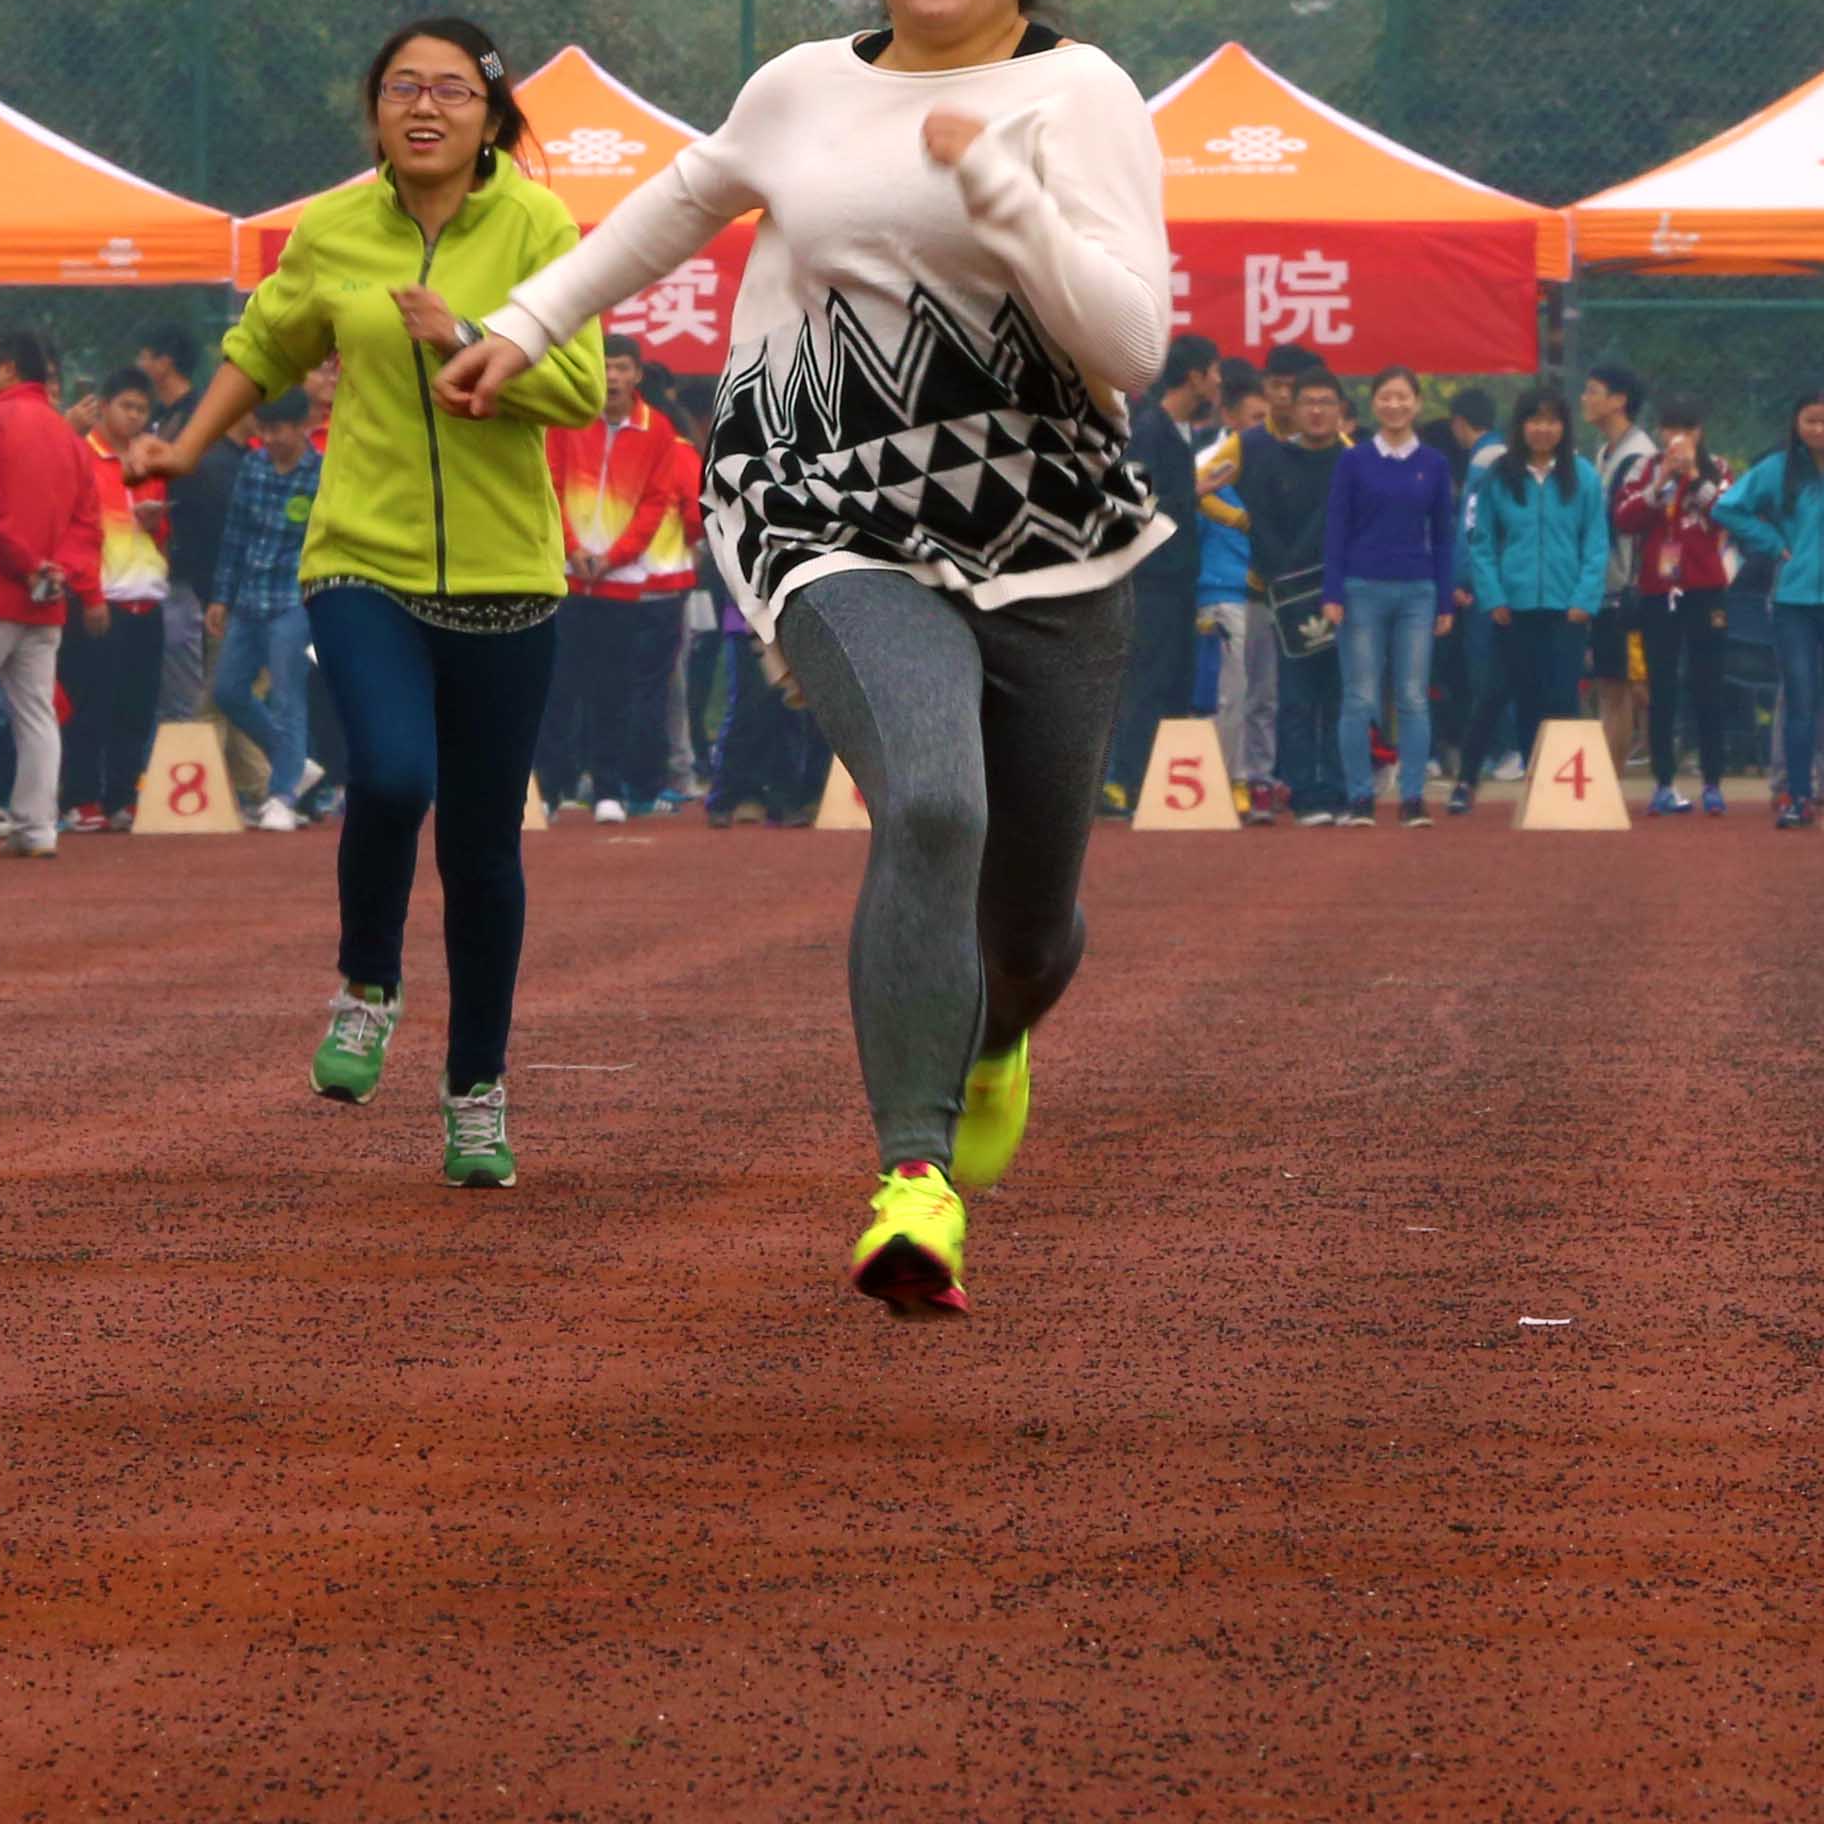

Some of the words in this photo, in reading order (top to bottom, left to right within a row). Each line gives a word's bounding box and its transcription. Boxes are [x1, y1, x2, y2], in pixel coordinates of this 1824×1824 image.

[169, 762, 208, 817] 8
[1165, 755, 1205, 811] 5
[1552, 746, 1593, 801] 4
